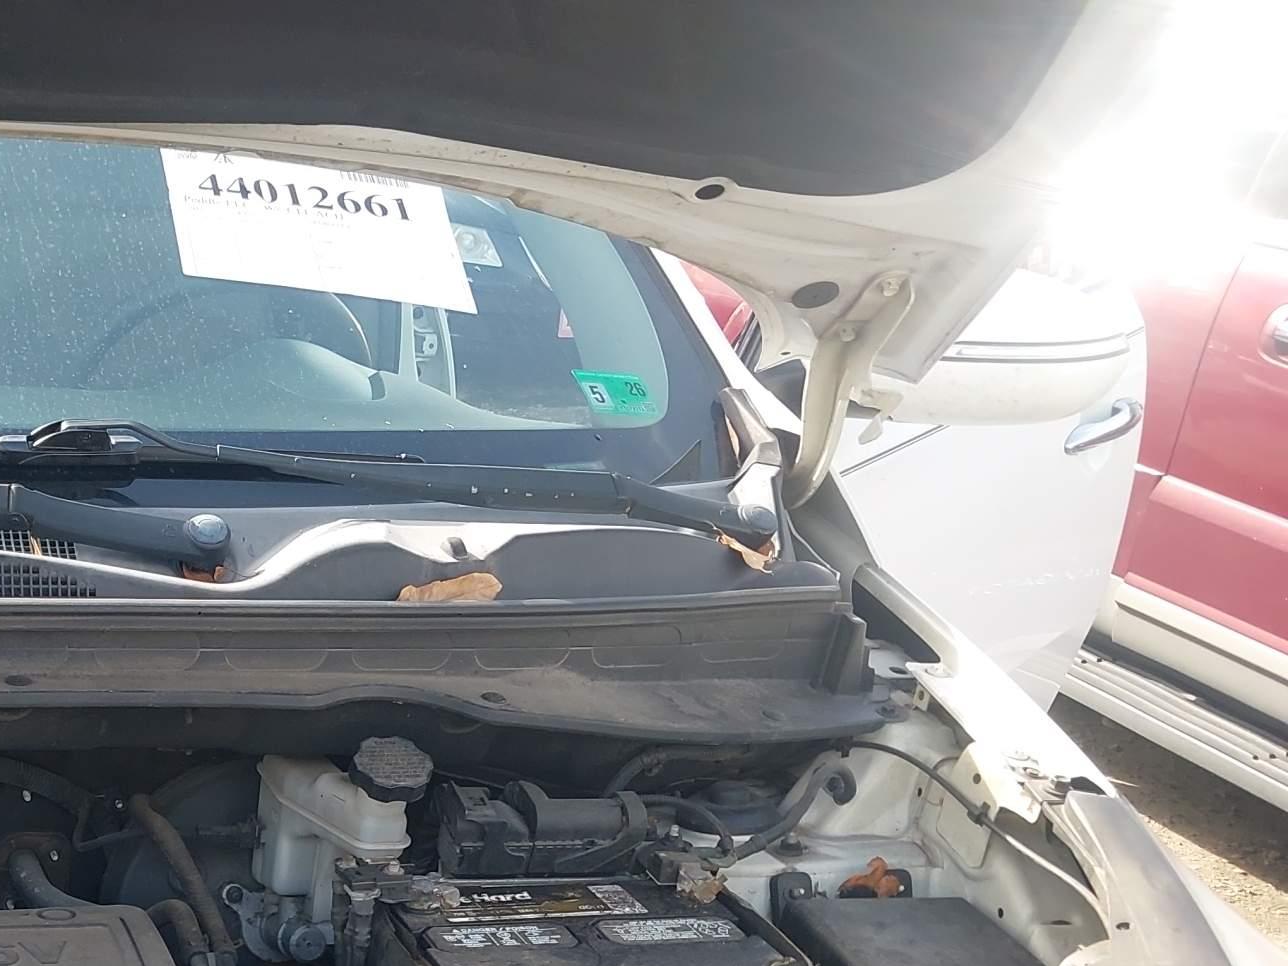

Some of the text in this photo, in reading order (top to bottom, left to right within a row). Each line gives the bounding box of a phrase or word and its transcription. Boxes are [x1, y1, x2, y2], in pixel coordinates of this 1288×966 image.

[198, 173, 410, 222] 44012661
[589, 381, 646, 404] 5 26
